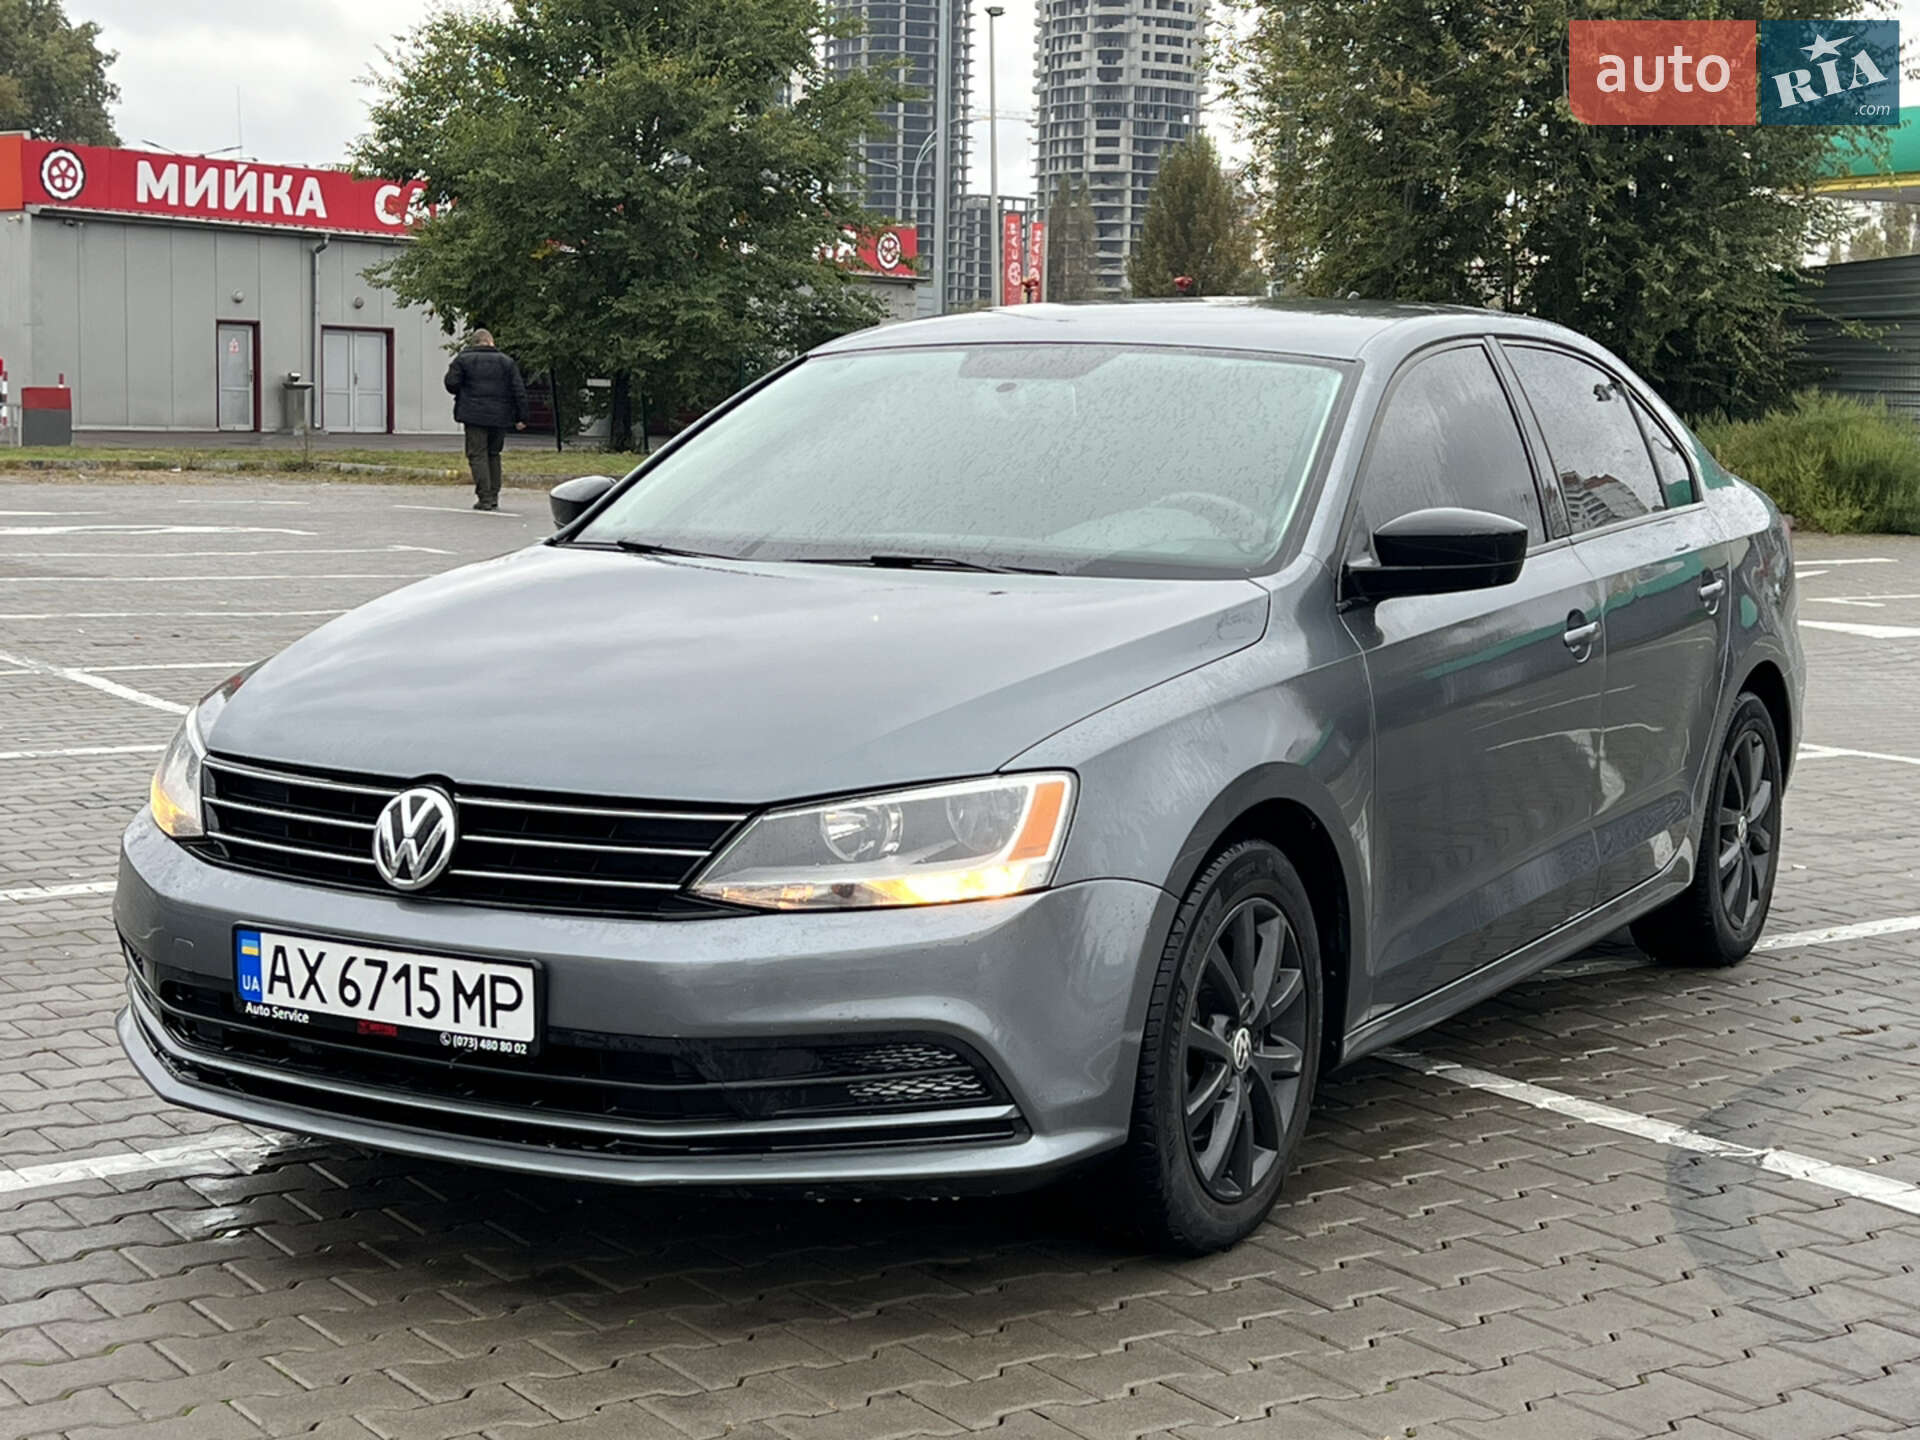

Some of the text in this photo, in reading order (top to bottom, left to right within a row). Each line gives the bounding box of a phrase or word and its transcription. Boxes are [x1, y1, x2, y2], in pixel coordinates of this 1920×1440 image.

[135, 159, 328, 219] МИЙКА
[242, 973, 261, 993] UA
[267, 945, 525, 1029] AX 6715 MP
[245, 1001, 310, 1024] Auto Service
[452, 1033, 479, 1051] (073)
[499, 1040, 513, 1054] 80
[513, 1043, 528, 1056] 02
